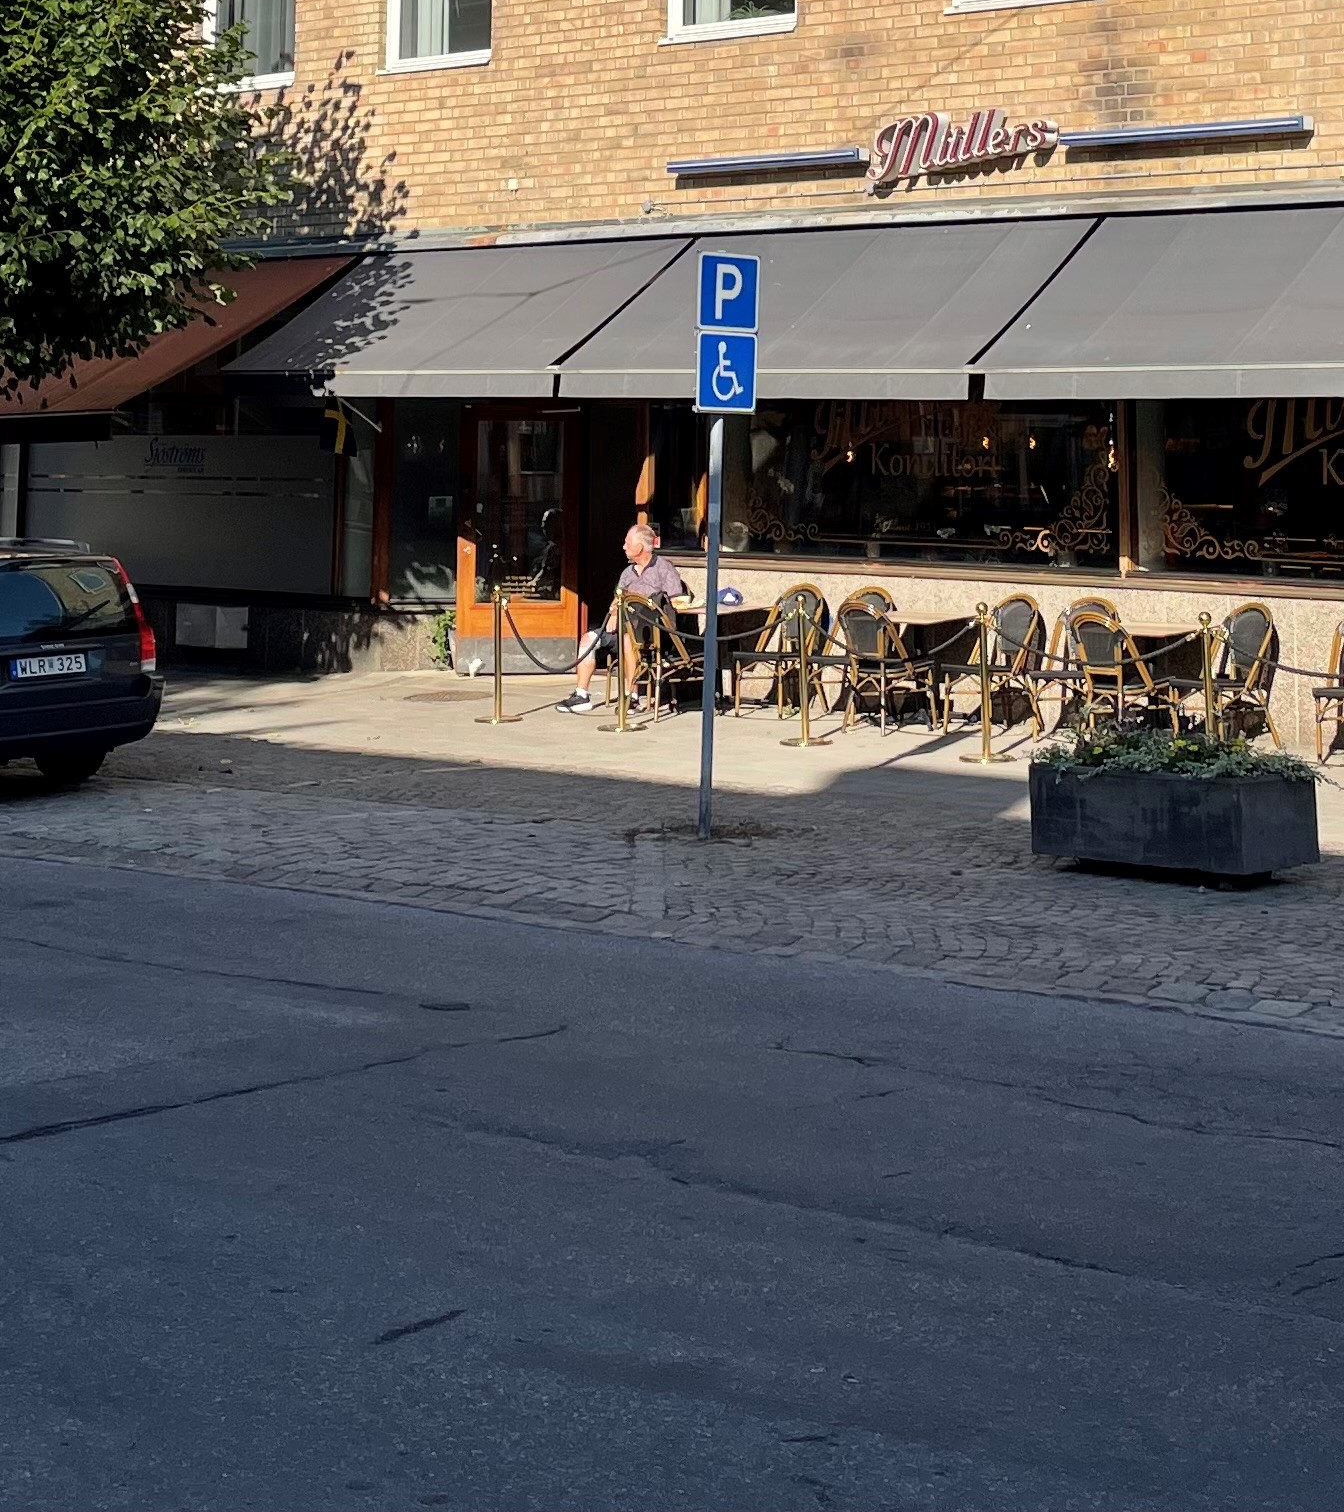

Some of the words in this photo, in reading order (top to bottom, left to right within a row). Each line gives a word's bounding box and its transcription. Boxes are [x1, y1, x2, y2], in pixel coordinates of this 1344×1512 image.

[714, 263, 744, 320] P
[18, 659, 47, 676] WLR
[56, 655, 84, 672] 325
